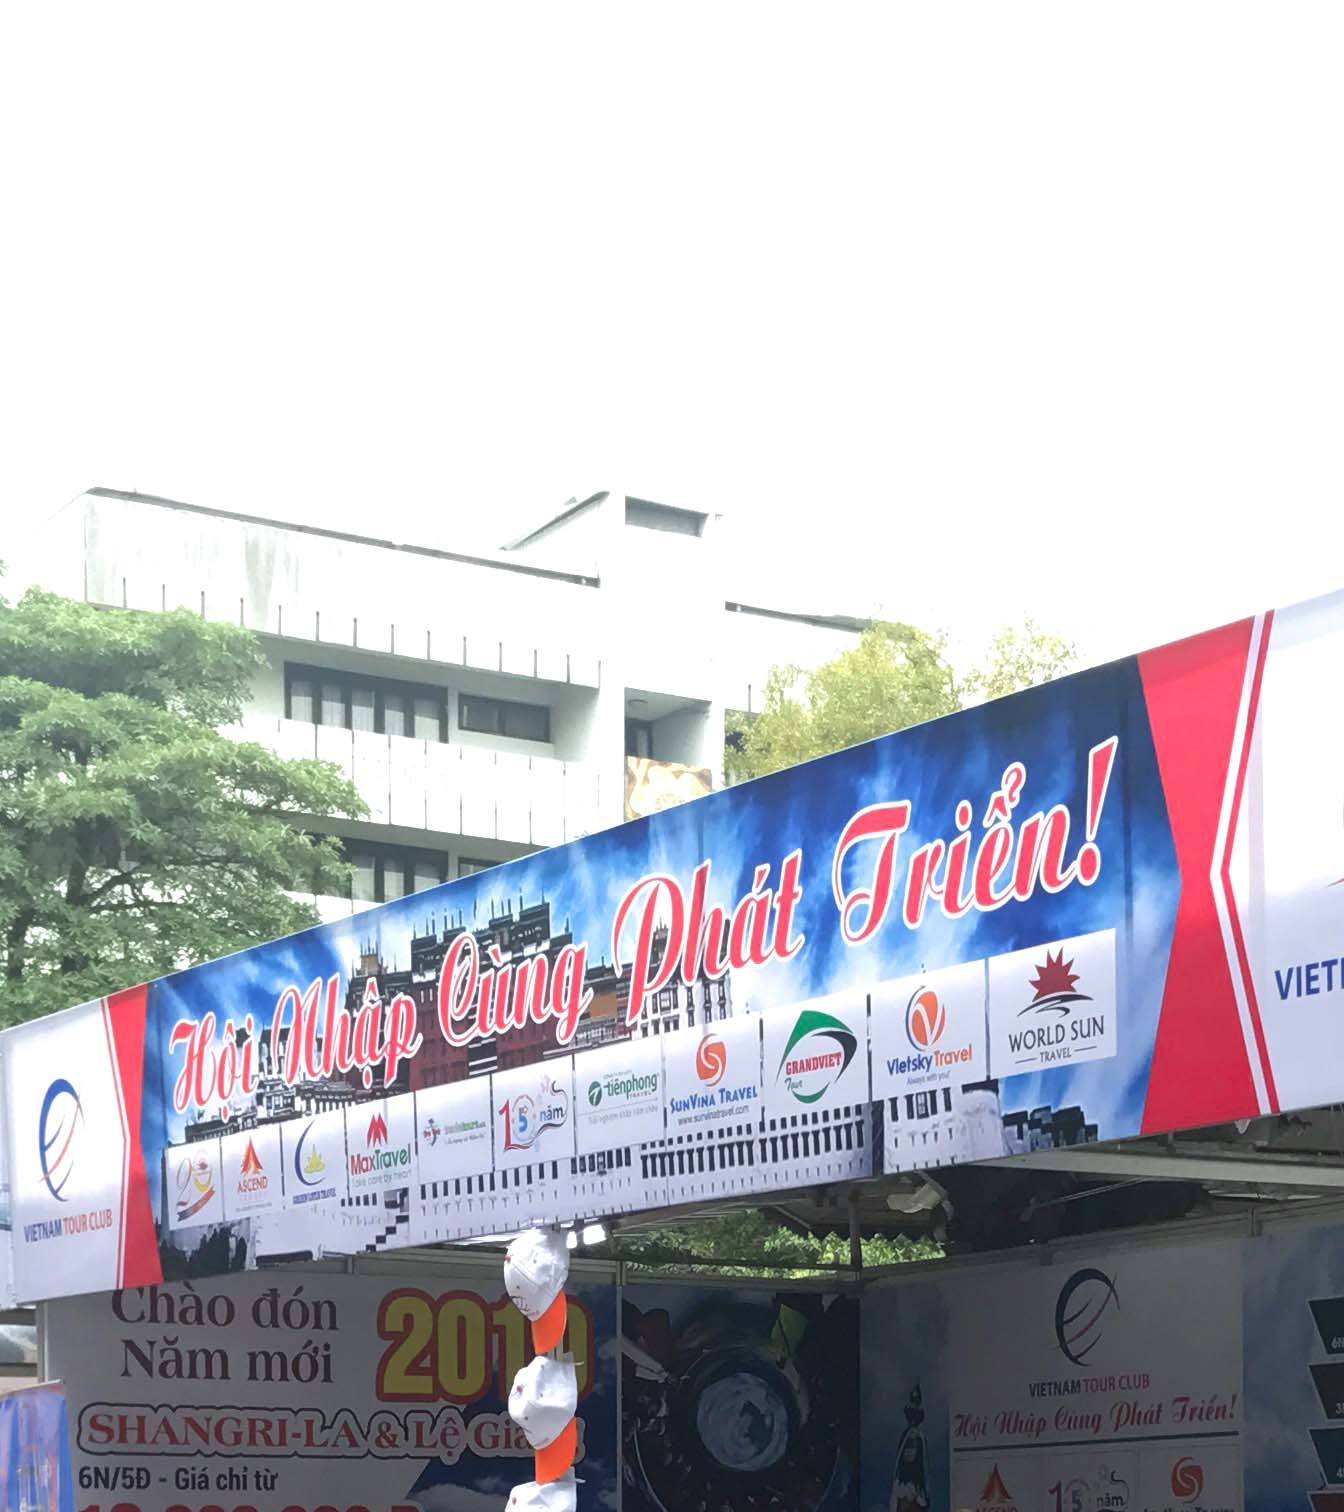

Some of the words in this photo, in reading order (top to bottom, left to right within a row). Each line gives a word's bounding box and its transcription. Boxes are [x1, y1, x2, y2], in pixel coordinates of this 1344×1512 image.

[169, 1011, 257, 1121] Hội
[272, 975, 422, 1097] Nhập
[439, 931, 594, 1044] Cùng
[613, 849, 805, 1026] Phát
[833, 735, 1119, 946] Triển!
[1008, 1022, 1065, 1053] WORLD
[1070, 1015, 1105, 1039] SUN
[785, 1052, 842, 1076] GRANDVIET
[1039, 1048, 1072, 1064] TRAVEL
[350, 1144, 411, 1176] MaxTravel
[237, 1176, 268, 1193] ASCEND
[24, 1218, 63, 1243] VIETNAM
[63, 1214, 87, 1238] TOUR
[89, 1208, 113, 1231] CLUB
[112, 1280, 236, 1327] Chào
[252, 1285, 339, 1331] đón
[121, 1337, 230, 1381] Năm
[247, 1337, 334, 1383] mới
[1029, 1379, 1081, 1398] VIETNAM
[1083, 1377, 1116, 1394] TOUR
[1118, 1374, 1150, 1391] CLUB
[1110, 1400, 1162, 1432] Phát
[88, 1413, 359, 1448] SHANGRI-LA
[375, 1421, 399, 1449] &
[413, 1413, 462, 1462] Lệ
[79, 1467, 150, 1490] 6N/5Đ
[175, 1465, 209, 1490] Giá
[213, 1466, 249, 1490] chỉ
[254, 1467, 279, 1491] từ
